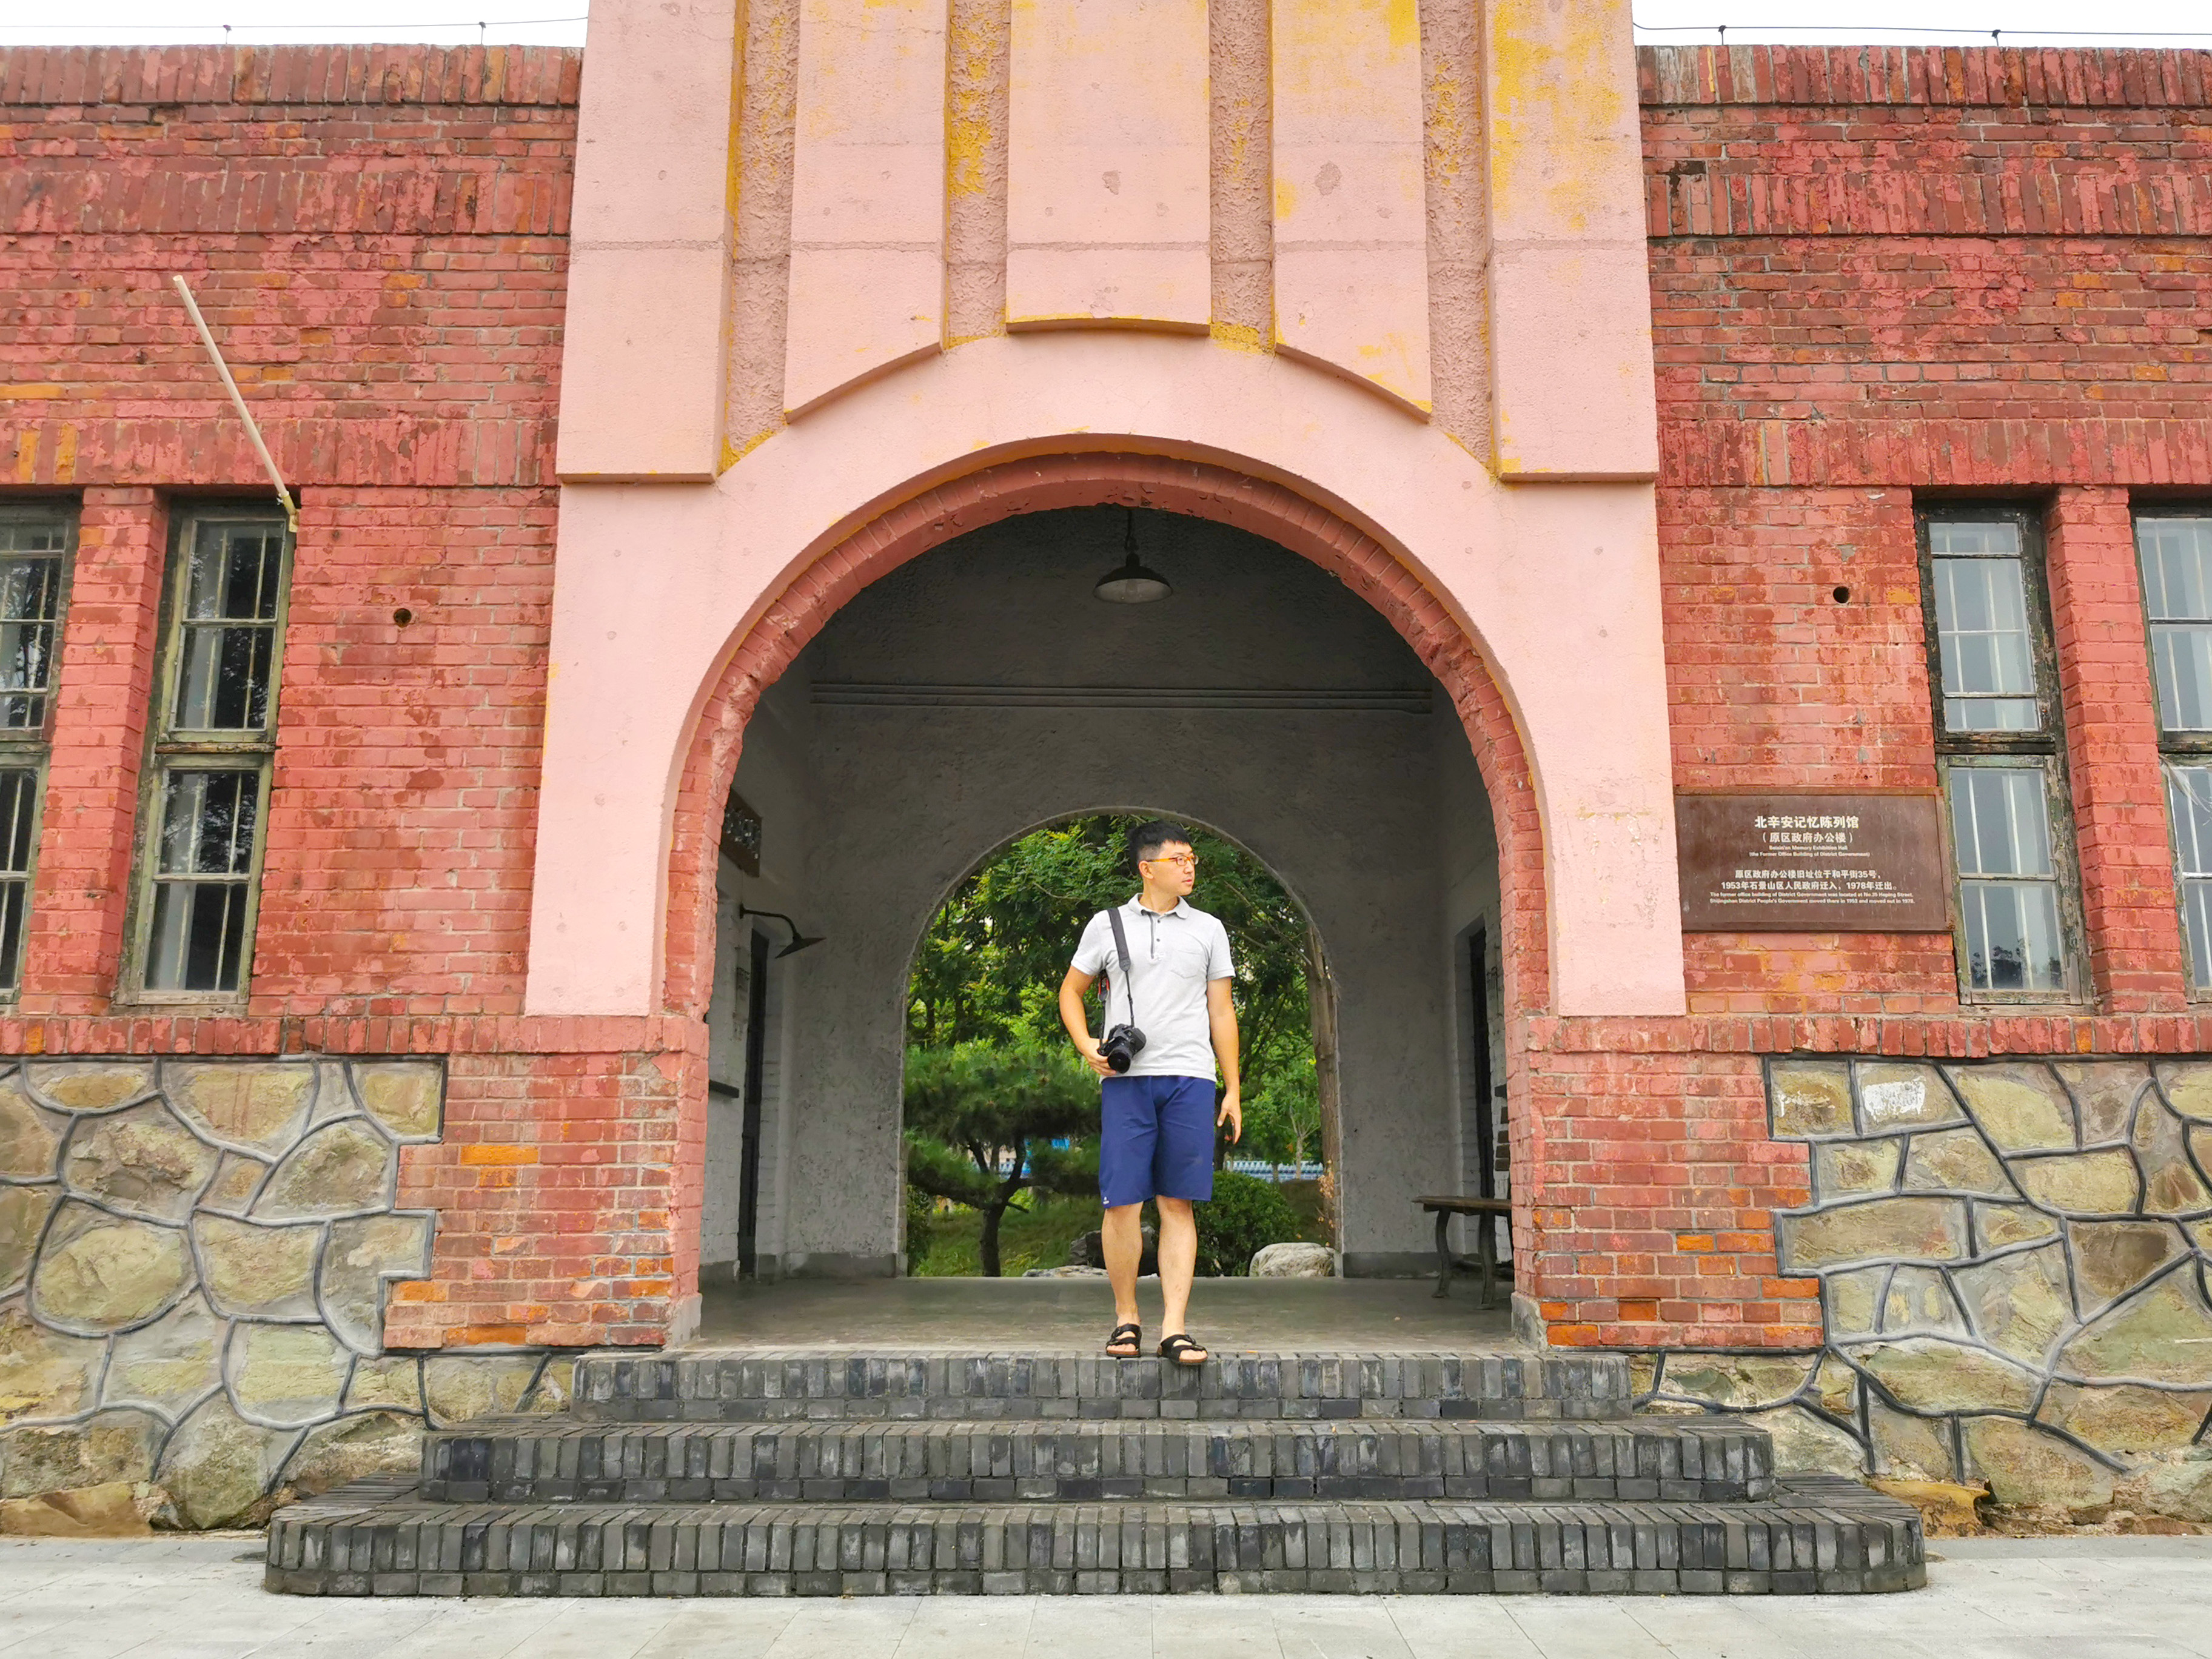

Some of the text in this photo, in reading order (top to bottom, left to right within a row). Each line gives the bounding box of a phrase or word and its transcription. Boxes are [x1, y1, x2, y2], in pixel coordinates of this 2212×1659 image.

[1754, 816, 1859, 829] 北辛安记忆陈列馆
